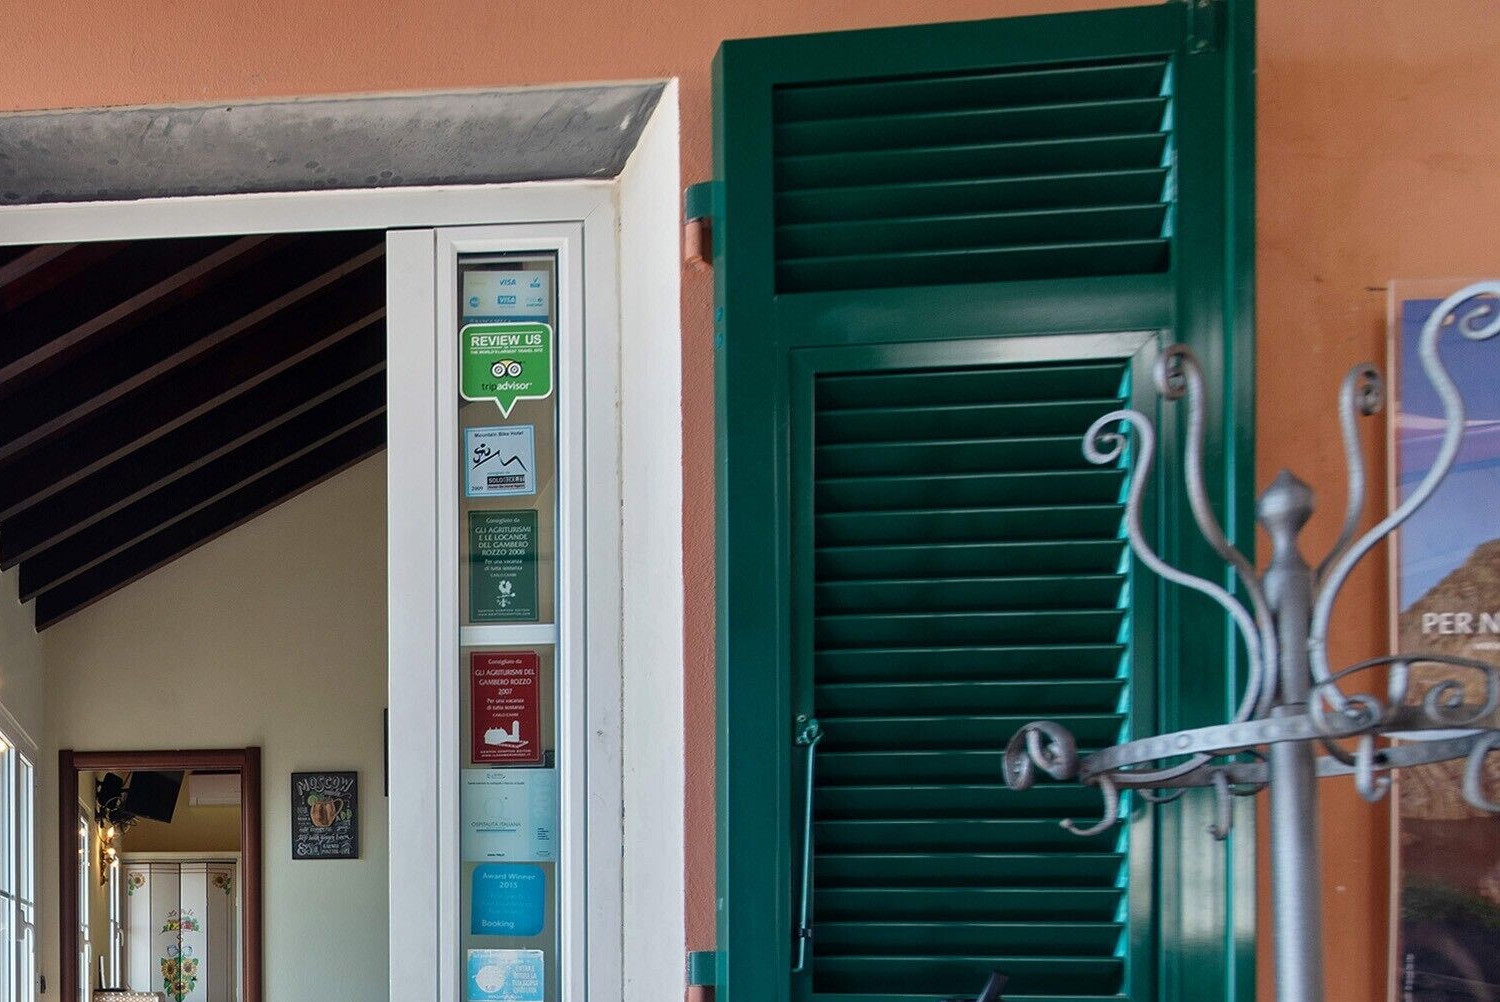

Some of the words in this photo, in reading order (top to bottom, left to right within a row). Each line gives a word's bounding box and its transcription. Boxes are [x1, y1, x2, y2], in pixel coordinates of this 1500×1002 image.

[471, 335, 520, 347] REVIEW
[525, 334, 542, 345] US
[482, 380, 530, 392] tripadvisor
[1422, 612, 1473, 634] PER
[479, 678, 510, 686] GAMBERO
[498, 688, 513, 696] 2007
[297, 776, 354, 795] MOSCOW
[482, 872, 507, 880] Award
[499, 881, 518, 889] 2015
[481, 919, 516, 929] Booking
